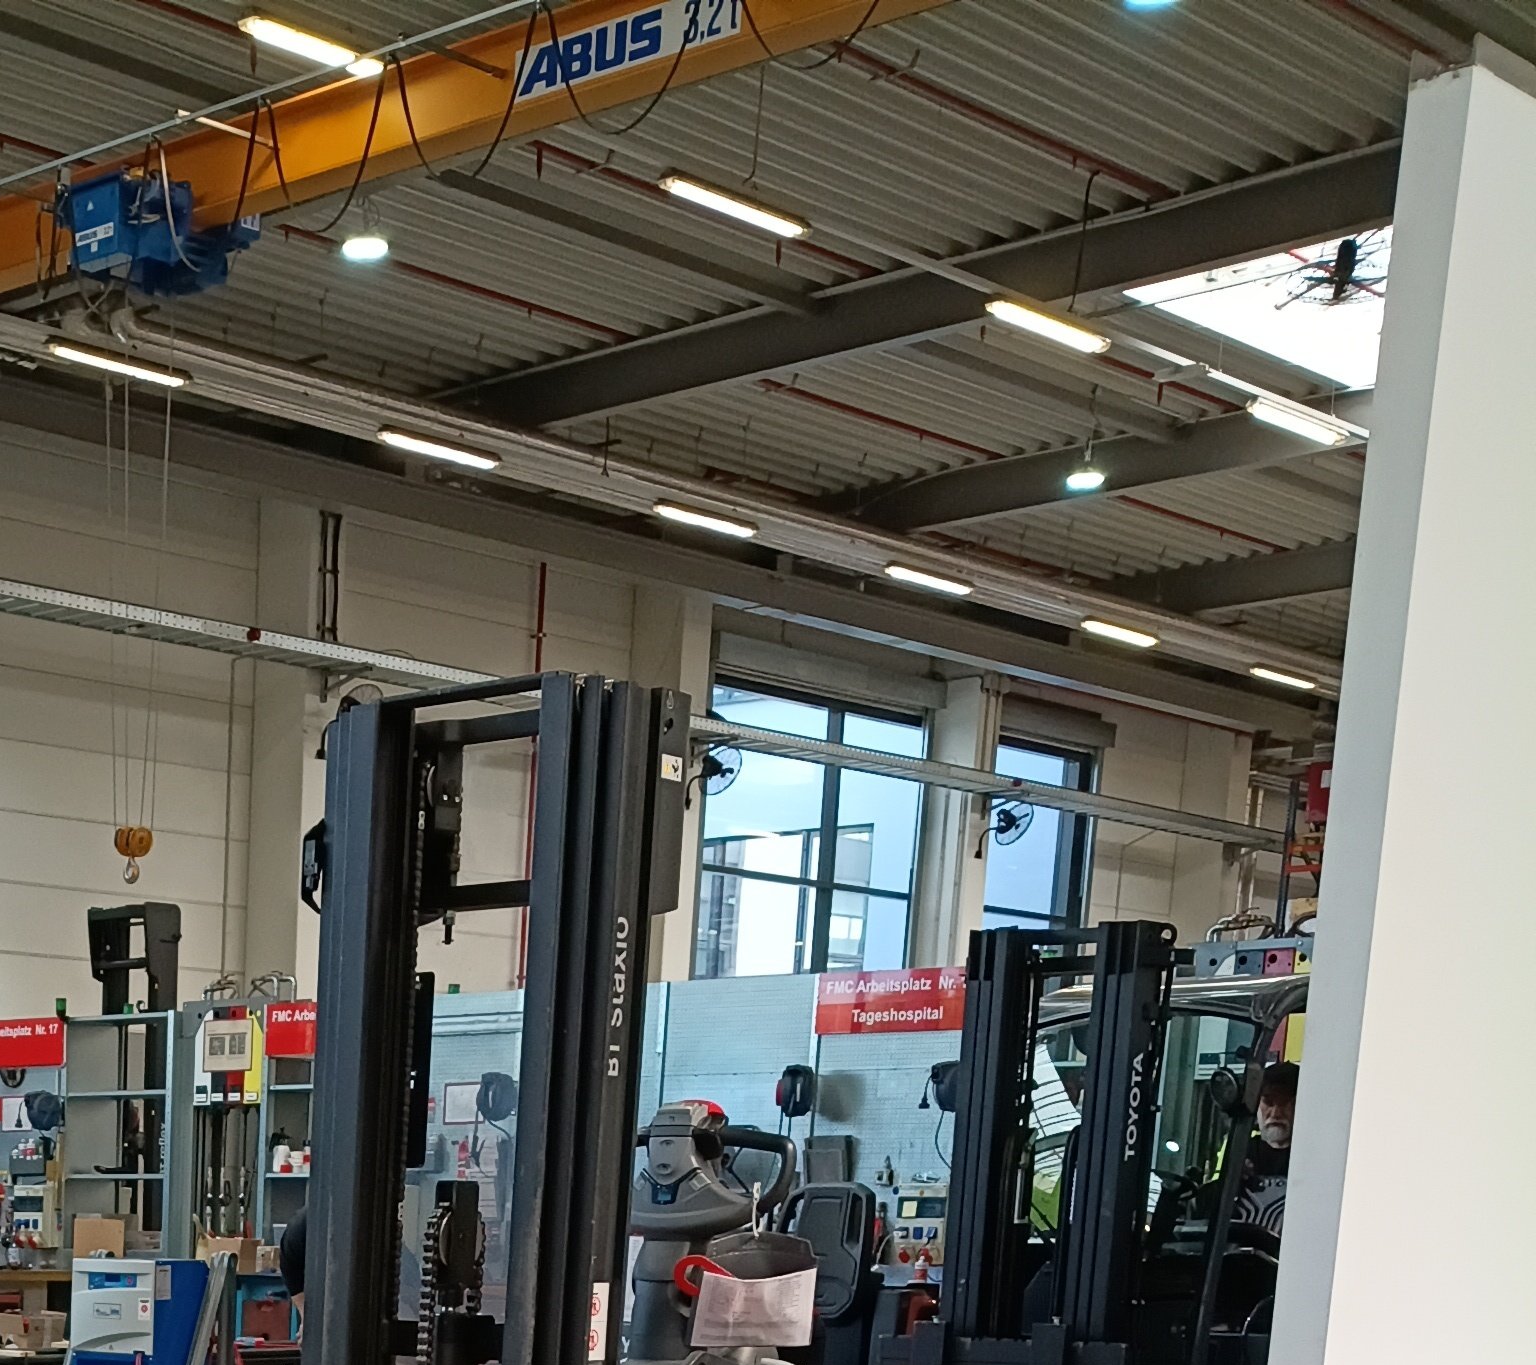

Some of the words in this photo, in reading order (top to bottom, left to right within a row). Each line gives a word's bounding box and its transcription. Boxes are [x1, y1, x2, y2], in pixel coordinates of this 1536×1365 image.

[519, 9, 663, 96] ABUS
[826, 980, 854, 994] FMC
[856, 977, 931, 994] Arbeitsplatz
[938, 976, 957, 990] Nr.
[272, 1010, 292, 1022] FMC
[294, 1009, 317, 1021] Arbe
[852, 1006, 944, 1025] Tageshospital
[35, 1024, 47, 1036] Nr.
[49, 1023, 59, 1035] 17
[1124, 1053, 1144, 1161] TOYOTA
